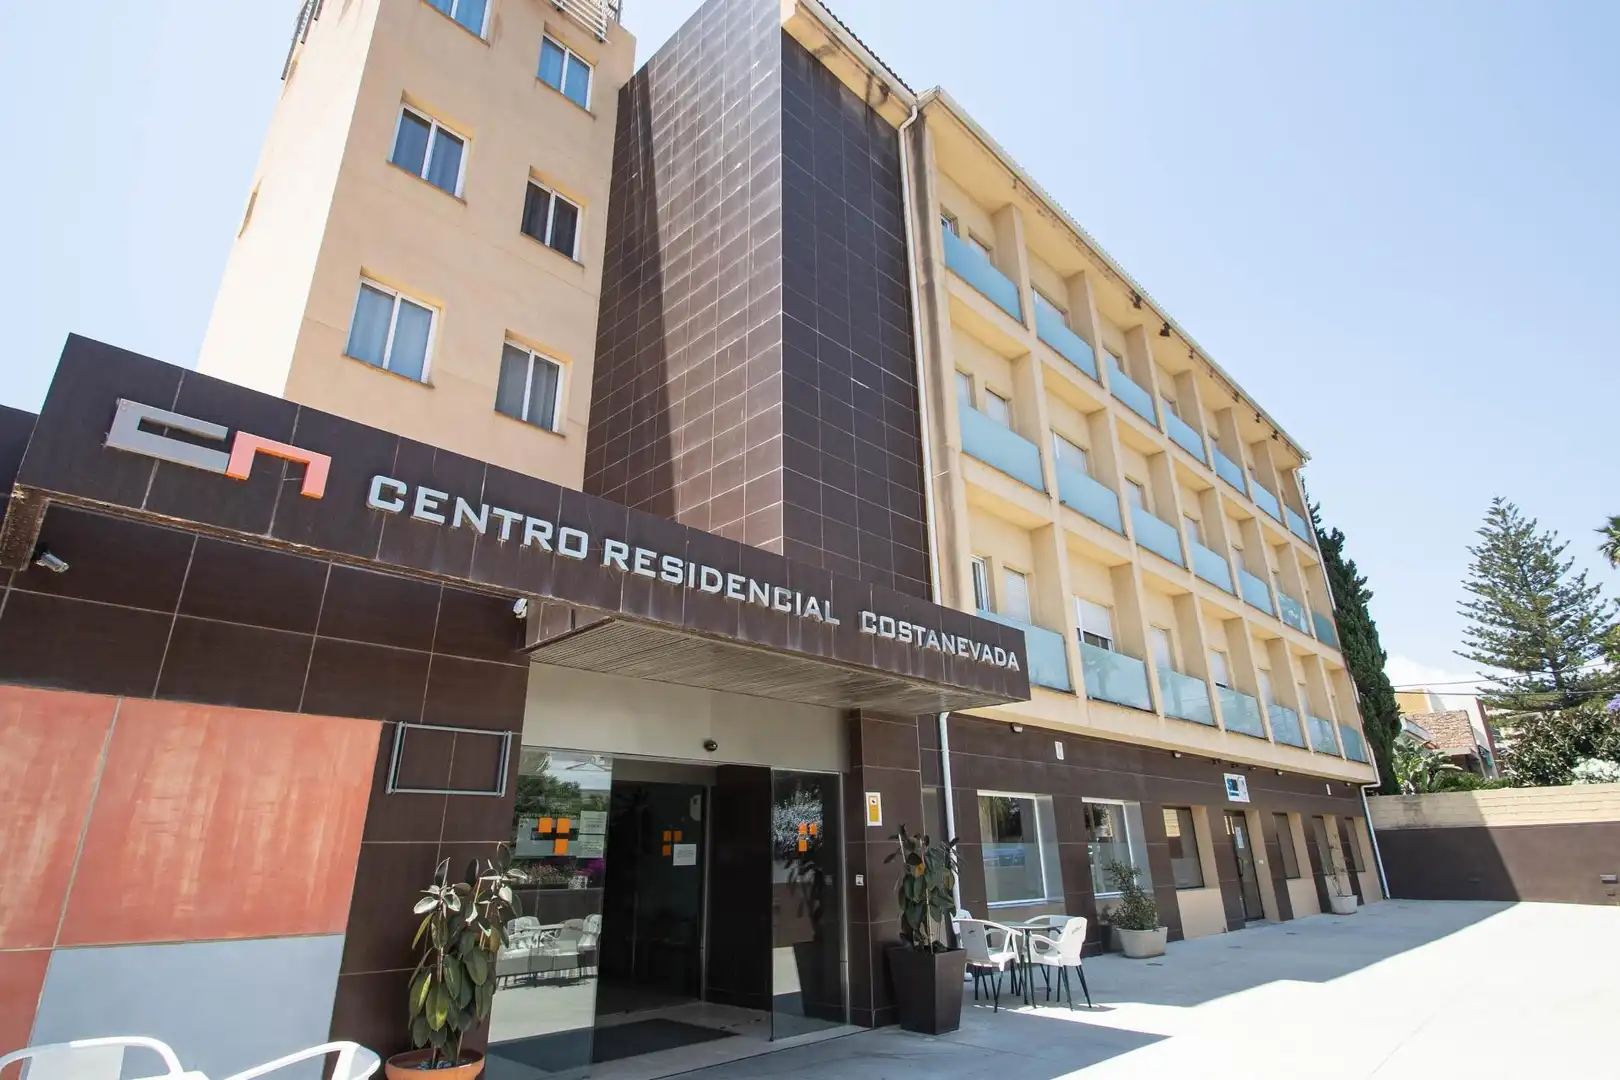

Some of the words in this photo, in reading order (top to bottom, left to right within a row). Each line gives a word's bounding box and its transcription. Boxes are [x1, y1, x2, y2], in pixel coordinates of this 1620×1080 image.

[367, 474, 589, 560] CENTRO
[602, 537, 840, 626] RESIDENCIAL
[859, 610, 1021, 672] COSTANEVADA
